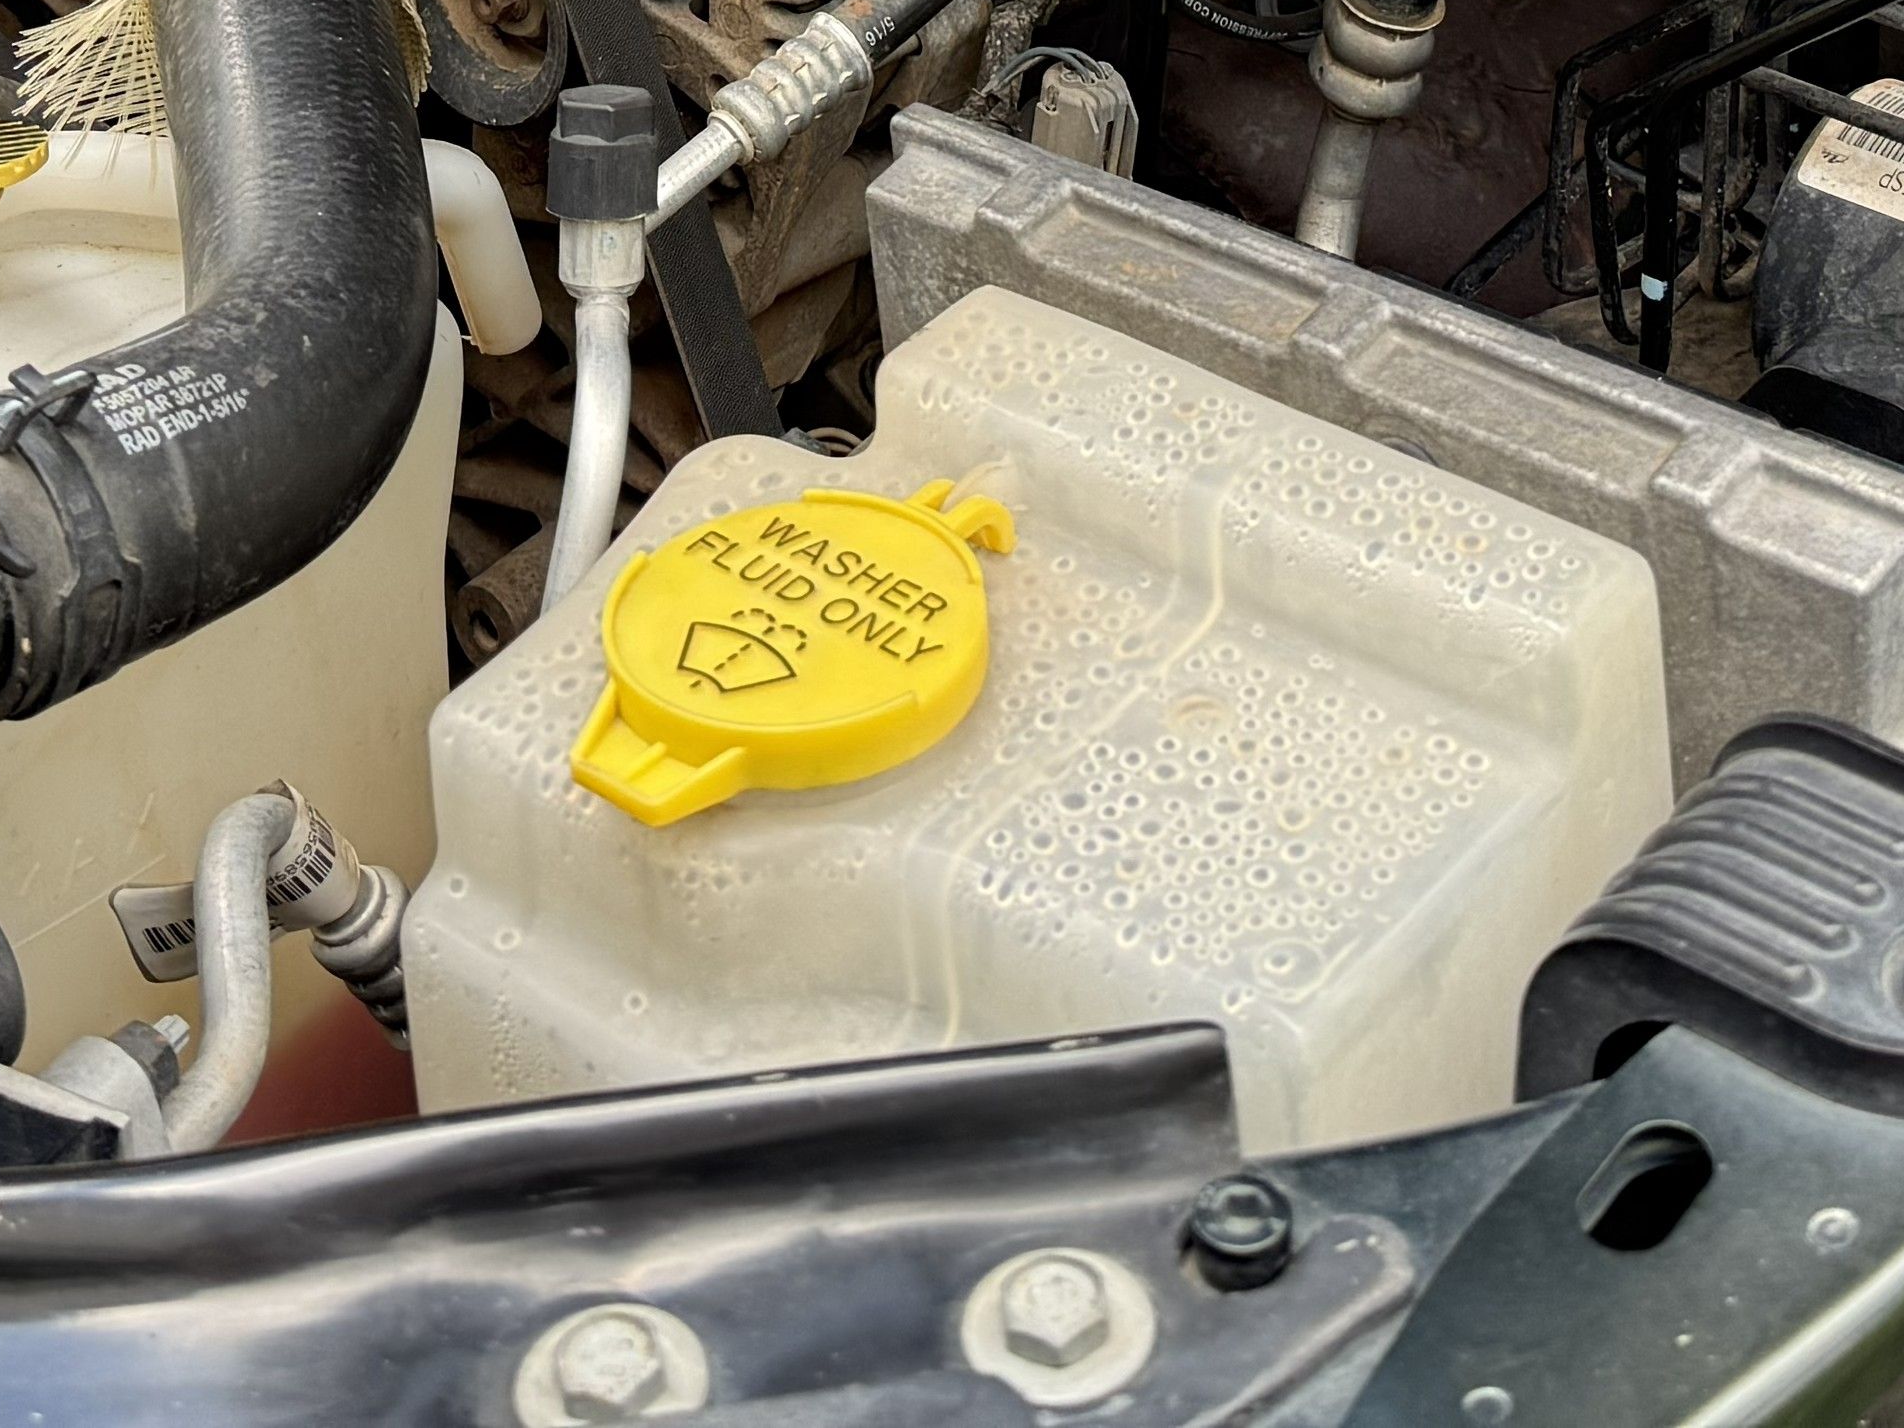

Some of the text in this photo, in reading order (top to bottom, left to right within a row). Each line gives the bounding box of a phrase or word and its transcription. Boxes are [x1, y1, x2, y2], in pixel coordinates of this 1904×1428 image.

[865, 16, 896, 47] 5/16
[104, 393, 174, 432] MOPAR
[118, 425, 161, 456] RAD
[759, 516, 948, 622] WASHER
[683, 530, 944, 664] FLUID ONLY
